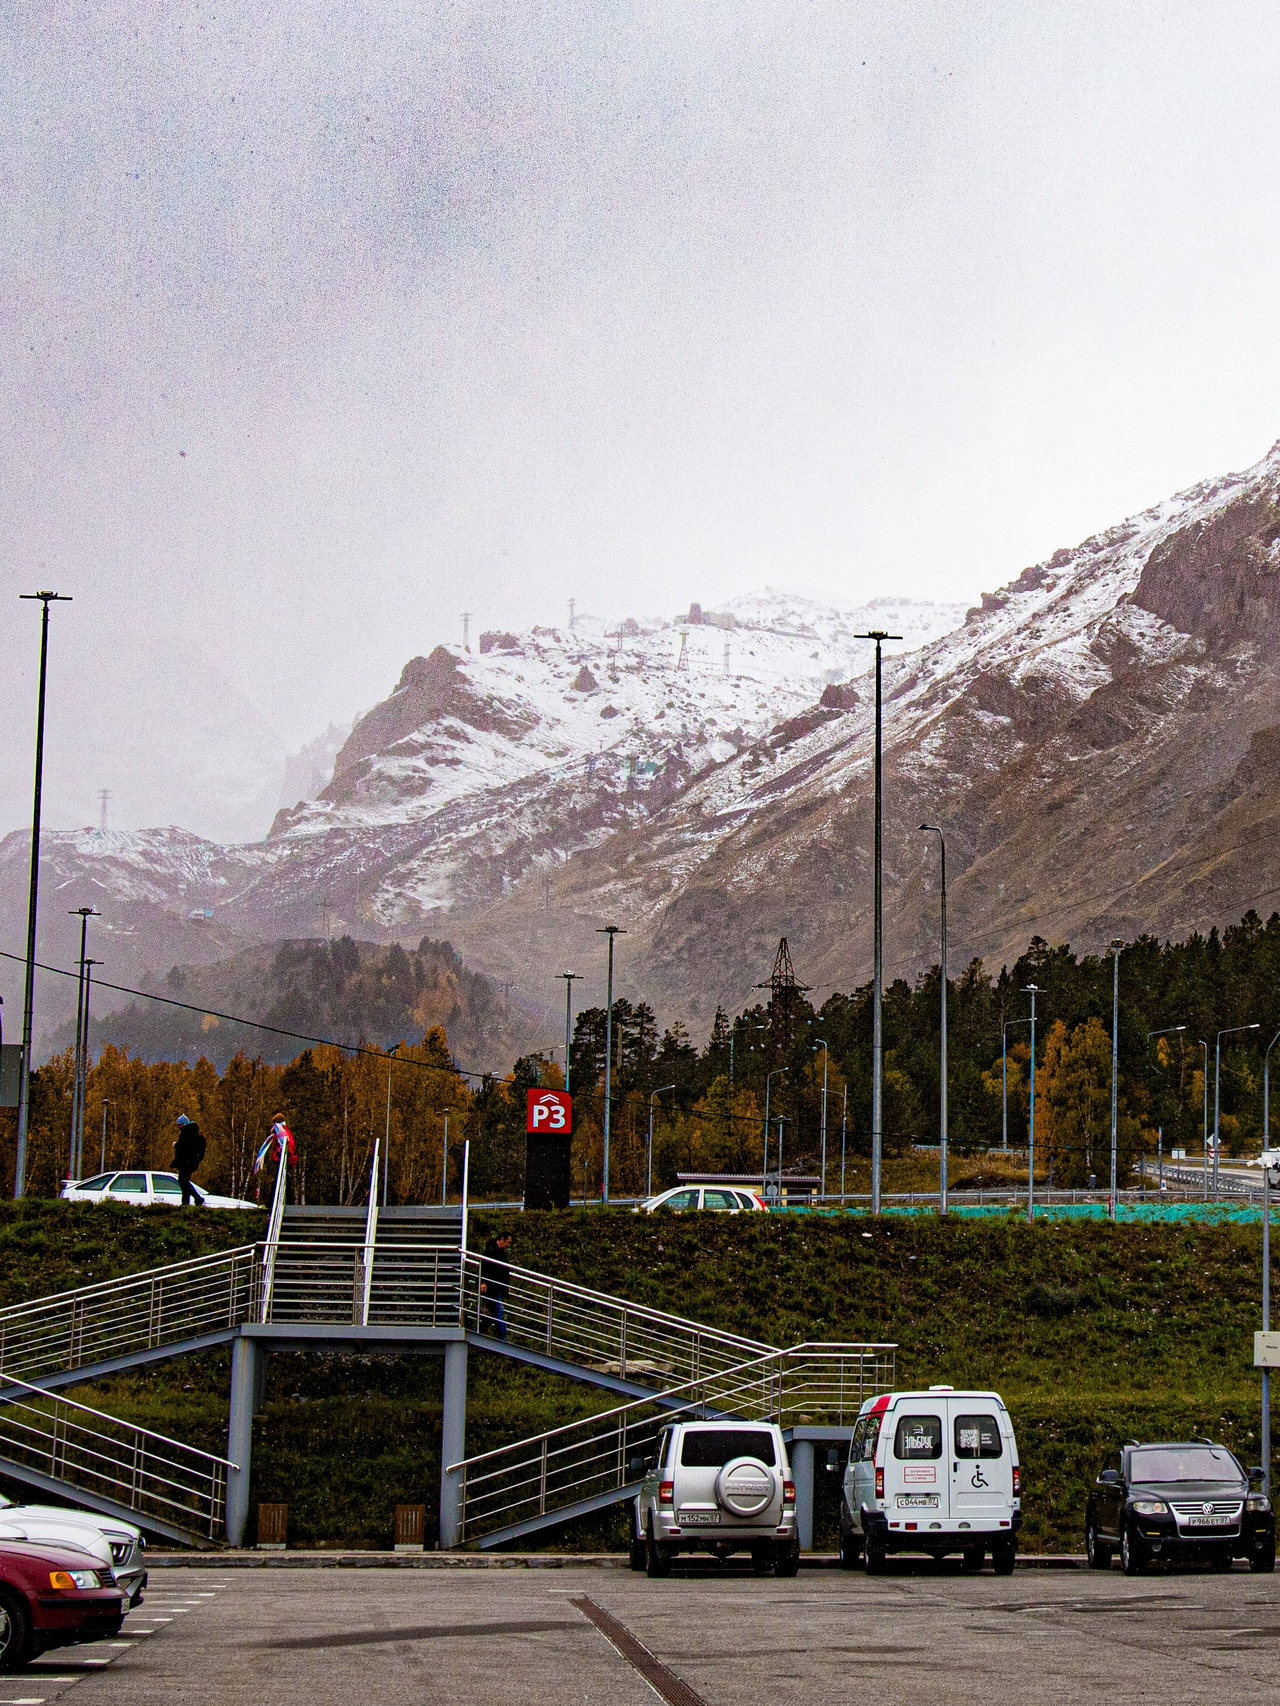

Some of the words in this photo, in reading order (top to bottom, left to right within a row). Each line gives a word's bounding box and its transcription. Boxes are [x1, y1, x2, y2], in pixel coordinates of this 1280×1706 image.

[532, 1104, 566, 1129] P3
[905, 1435, 934, 1449] ЭЛЬБРУС
[724, 1482, 771, 1492] PATRIOT
